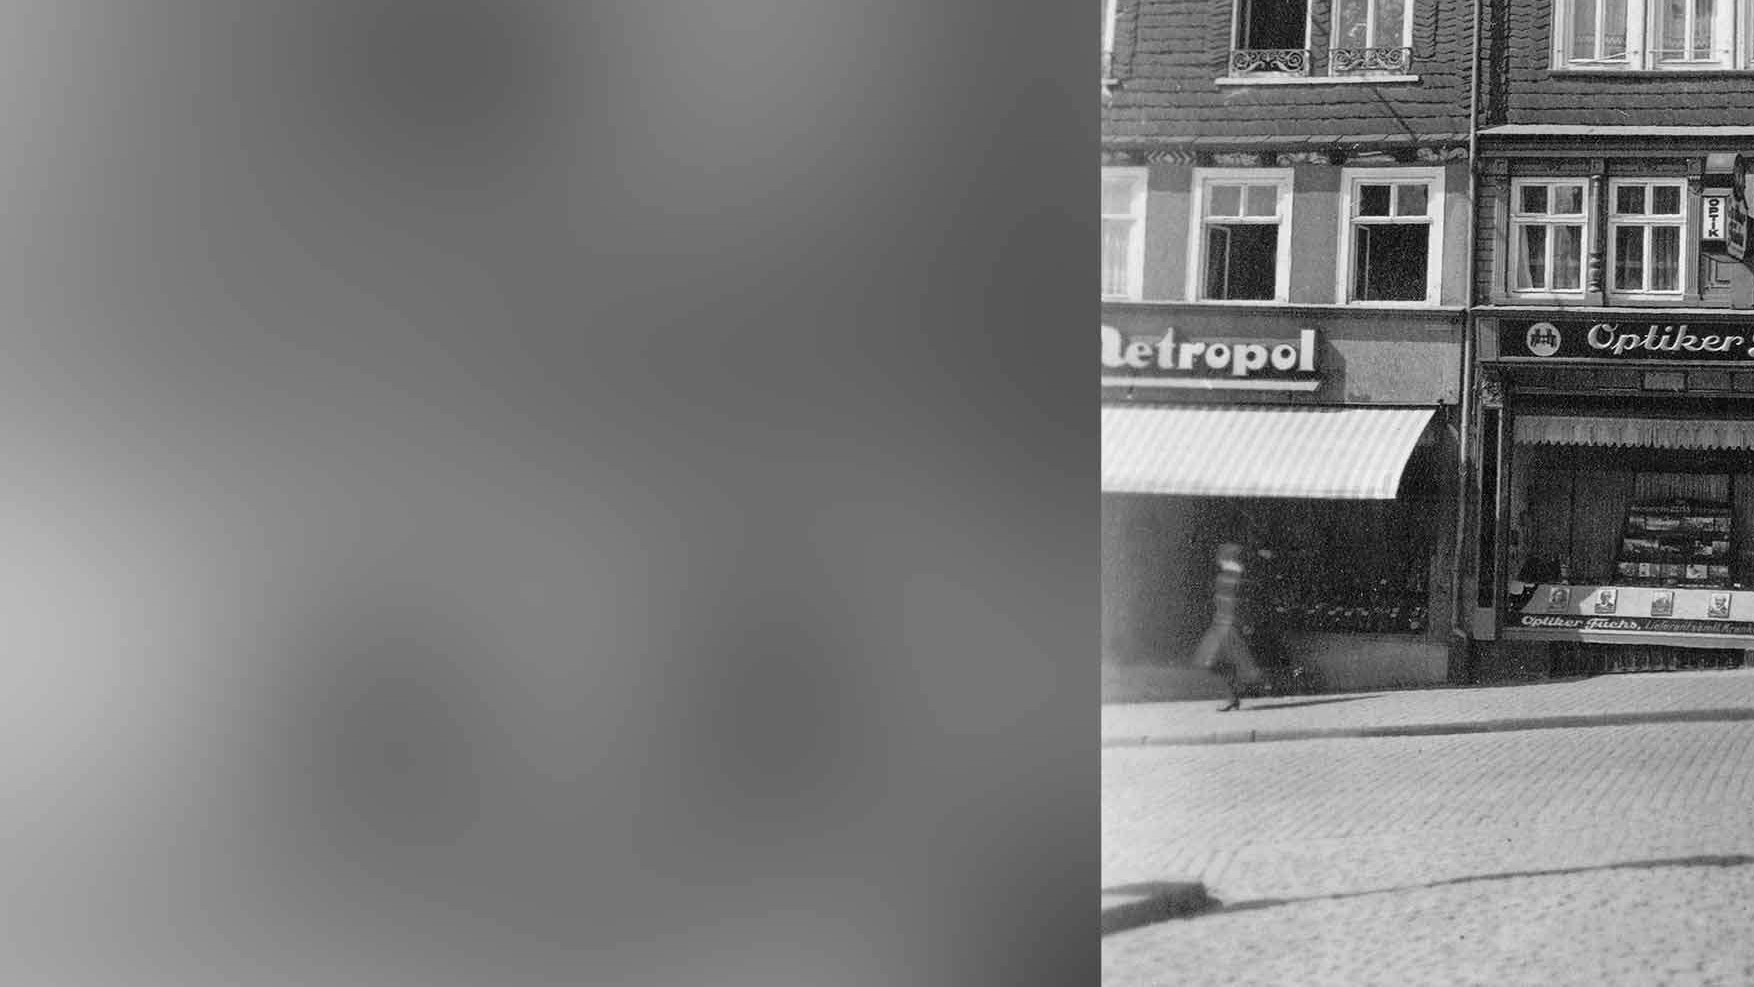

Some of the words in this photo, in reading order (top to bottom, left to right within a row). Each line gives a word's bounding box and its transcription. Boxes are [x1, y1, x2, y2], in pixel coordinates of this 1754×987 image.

[1708, 199, 1720, 238] OPTIK
[1587, 323, 1745, 355] Optiker
[1521, 615, 1583, 627] Optiker
